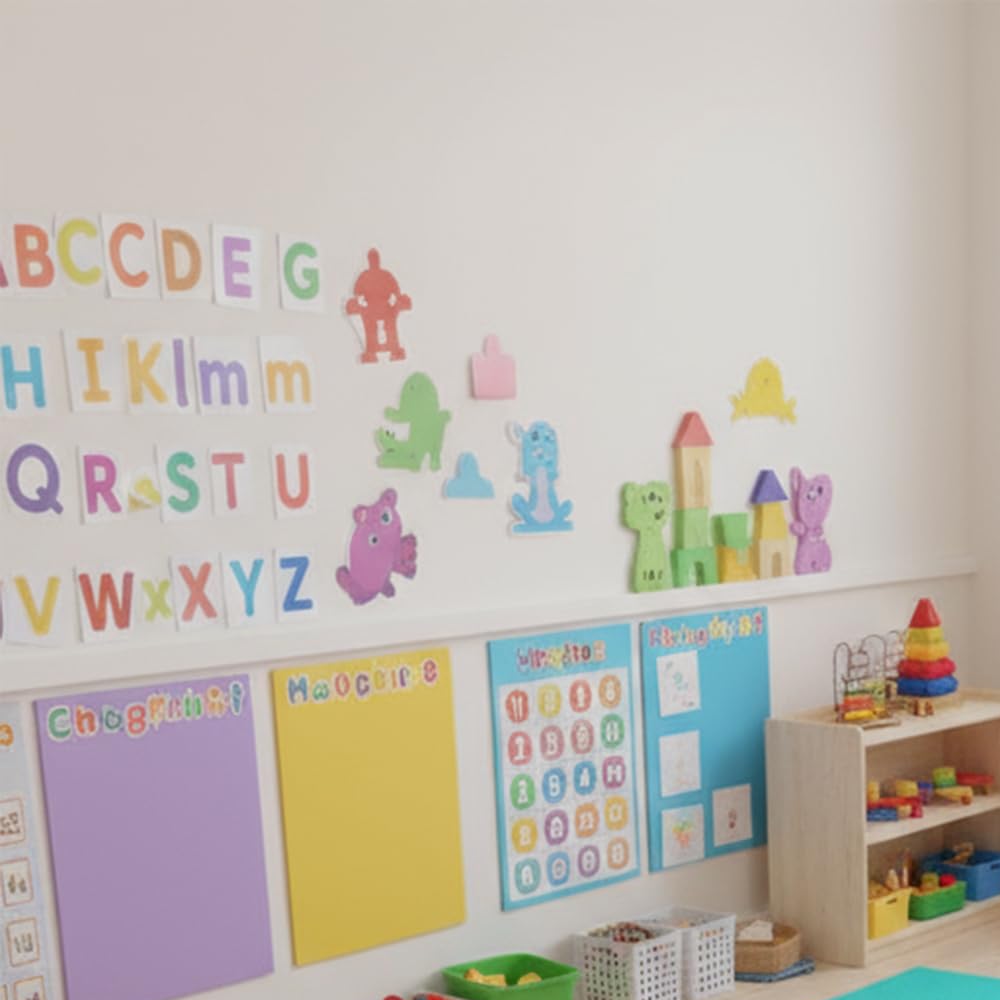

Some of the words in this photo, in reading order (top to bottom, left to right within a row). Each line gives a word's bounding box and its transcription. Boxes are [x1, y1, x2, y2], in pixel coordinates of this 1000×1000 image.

[222, 235, 253, 299] E
[283, 242, 320, 300] G
[6, 443, 64, 515] Q
[211, 452, 245, 510] T
[275, 453, 310, 509] U
[279, 556, 313, 612] Z
